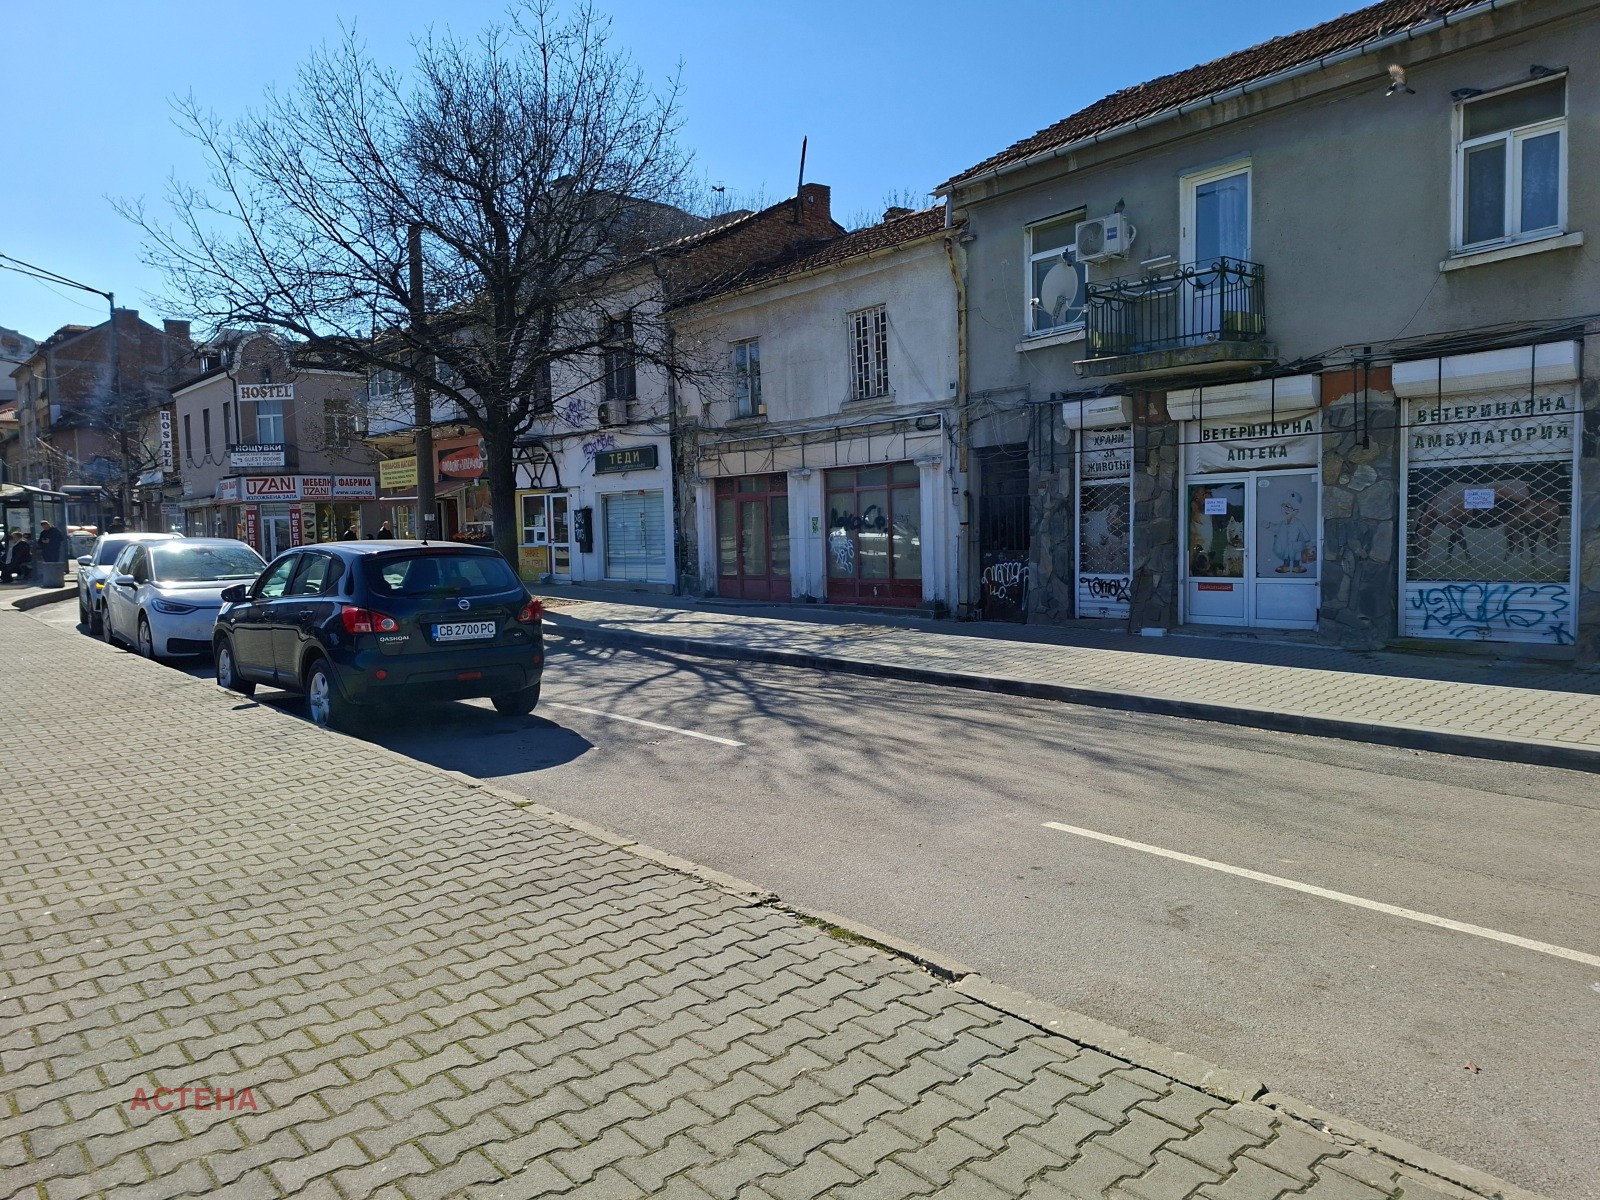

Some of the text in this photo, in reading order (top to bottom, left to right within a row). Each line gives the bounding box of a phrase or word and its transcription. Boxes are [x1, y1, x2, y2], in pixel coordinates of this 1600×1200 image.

[241, 385, 292, 399] HOSTEL
[1417, 396, 1567, 423] ВЕТЕРИНАРНА
[1203, 420, 1313, 441] ВЕТЕРИНАРНА
[1415, 425, 1568, 449] АМБУЛАТОРИЯ
[160, 412, 172, 467] HOSTEL
[1094, 433, 1124, 446] ХРАНИ
[235, 444, 282, 452] НОЩУВКИ
[1104, 449, 1115, 458] ЗА
[1227, 445, 1288, 461] АПТЕКА
[609, 450, 640, 465] ТЕДИ
[245, 477, 297, 495] UZANI
[302, 478, 371, 487] МЕБЕЛН ФАБРИКА
[303, 487, 329, 496] UZANI
[248, 514, 256, 550] МЕБЕЛ
[291, 512, 300, 546] МЕБЕЛ
[439, 623, 494, 637] CB 2700 PC
[379, 635, 410, 643] QASHQAI
